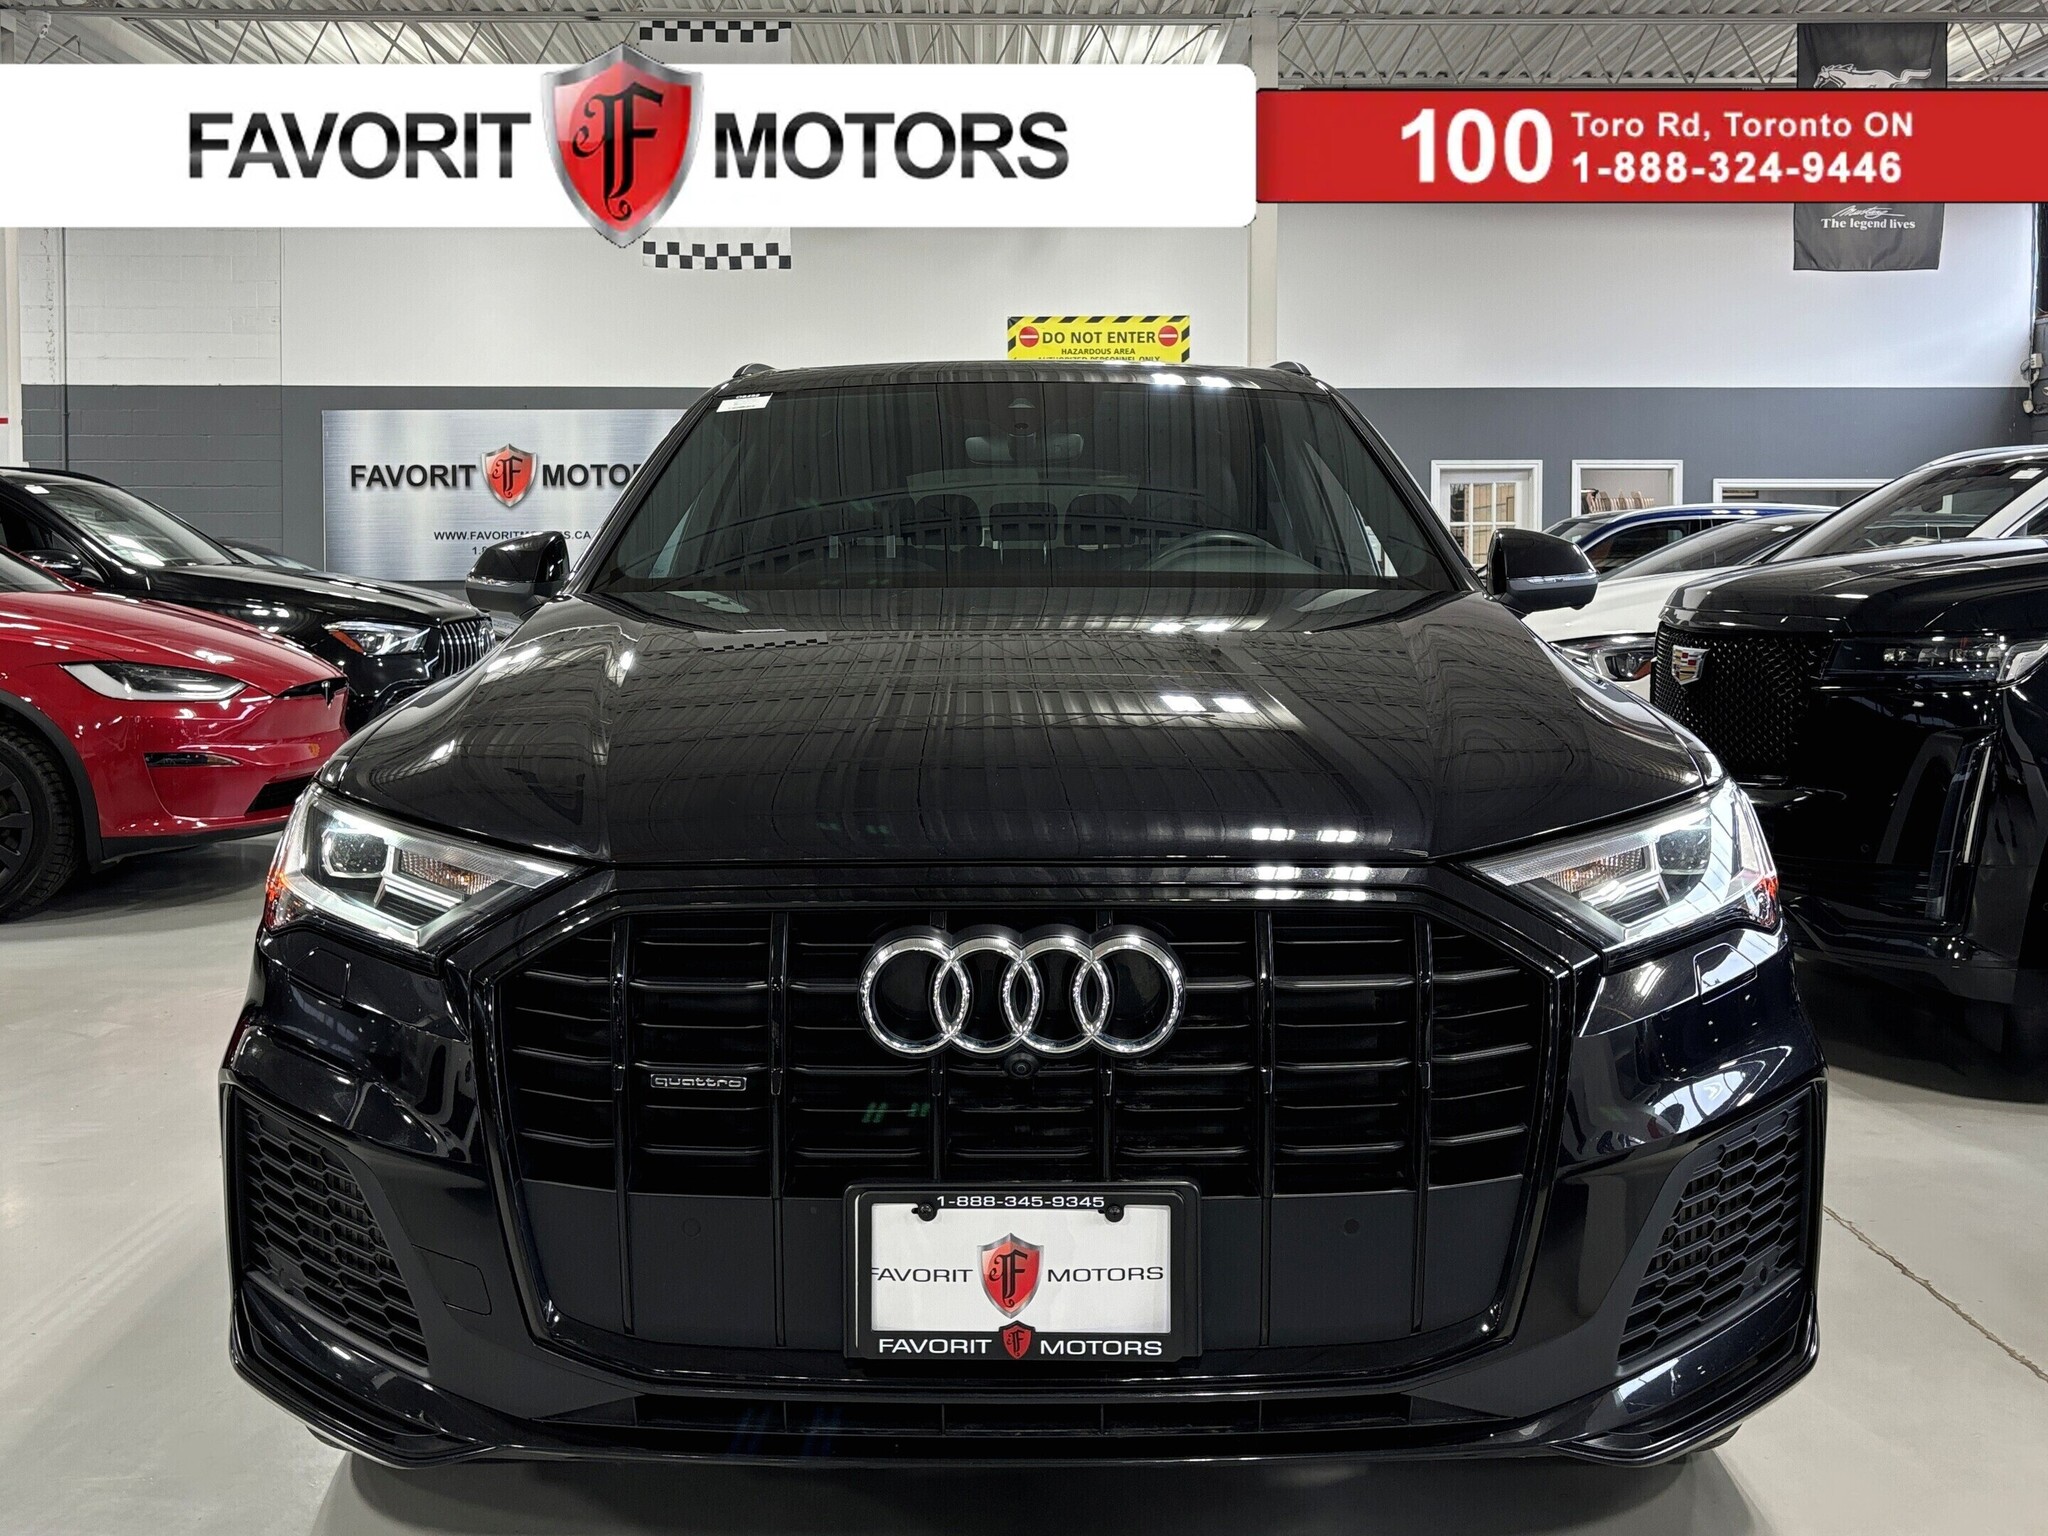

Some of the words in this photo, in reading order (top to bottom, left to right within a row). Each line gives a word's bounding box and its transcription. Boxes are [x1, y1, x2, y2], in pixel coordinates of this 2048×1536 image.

[1821, 218, 1846, 229] The
[1850, 218, 1887, 230] legend
[1889, 218, 1916, 229] lives
[1042, 331, 1065, 344] DO
[1070, 331, 1103, 344] NOT
[1107, 331, 1156, 344] ENTER
[1113, 347, 1136, 355] AREA
[350, 464, 477, 488] FAVORIT
[542, 463, 642, 487] MOTO
[434, 531, 591, 540] WWW.FAVORITS.CA
[654, 1077, 742, 1088] quattro
[936, 1195, 1105, 1208] 1-888-345-9345
[1047, 1266, 1164, 1283] MOTORS
[879, 1338, 992, 1354] FAVORIT
[1040, 1339, 1163, 1356] MOTORS
